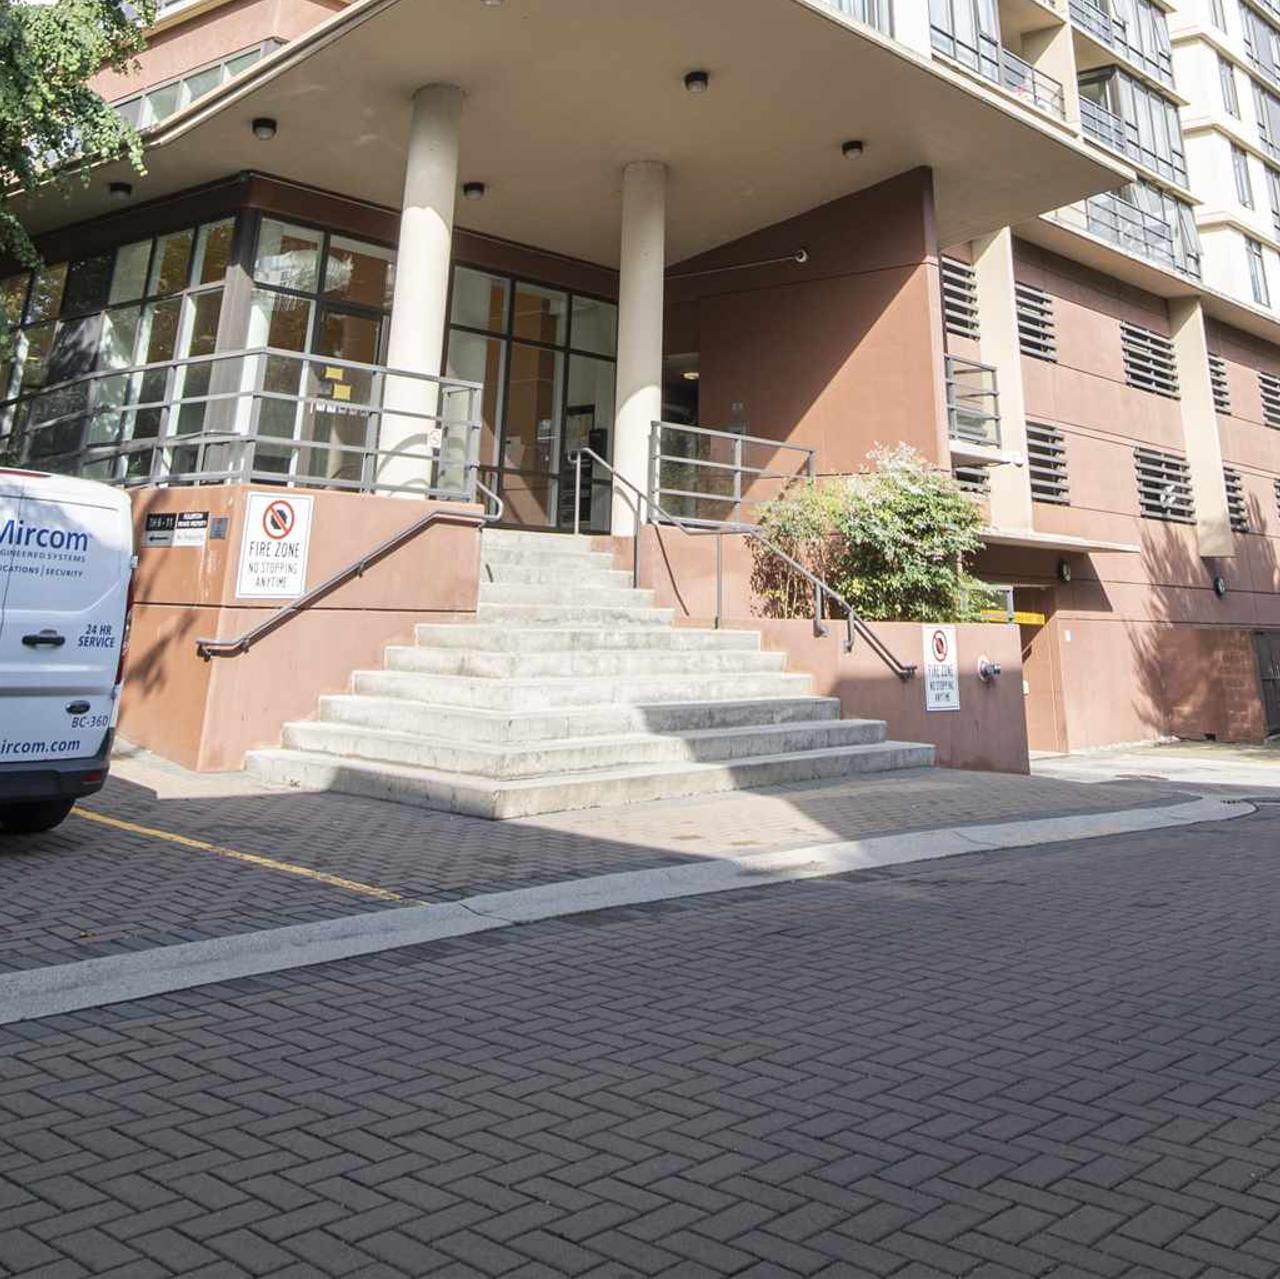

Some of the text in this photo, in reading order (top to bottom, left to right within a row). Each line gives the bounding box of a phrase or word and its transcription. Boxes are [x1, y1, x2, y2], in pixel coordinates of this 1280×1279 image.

[248, 541, 300, 559] FIRE ZONE
[47, 553, 86, 563] SYSTEMS
[248, 561, 298, 575] NO STOPPING
[255, 576, 287, 589] ANYTIME
[85, 624, 112, 636] 24 HR
[78, 636, 116, 648] SERVICE
